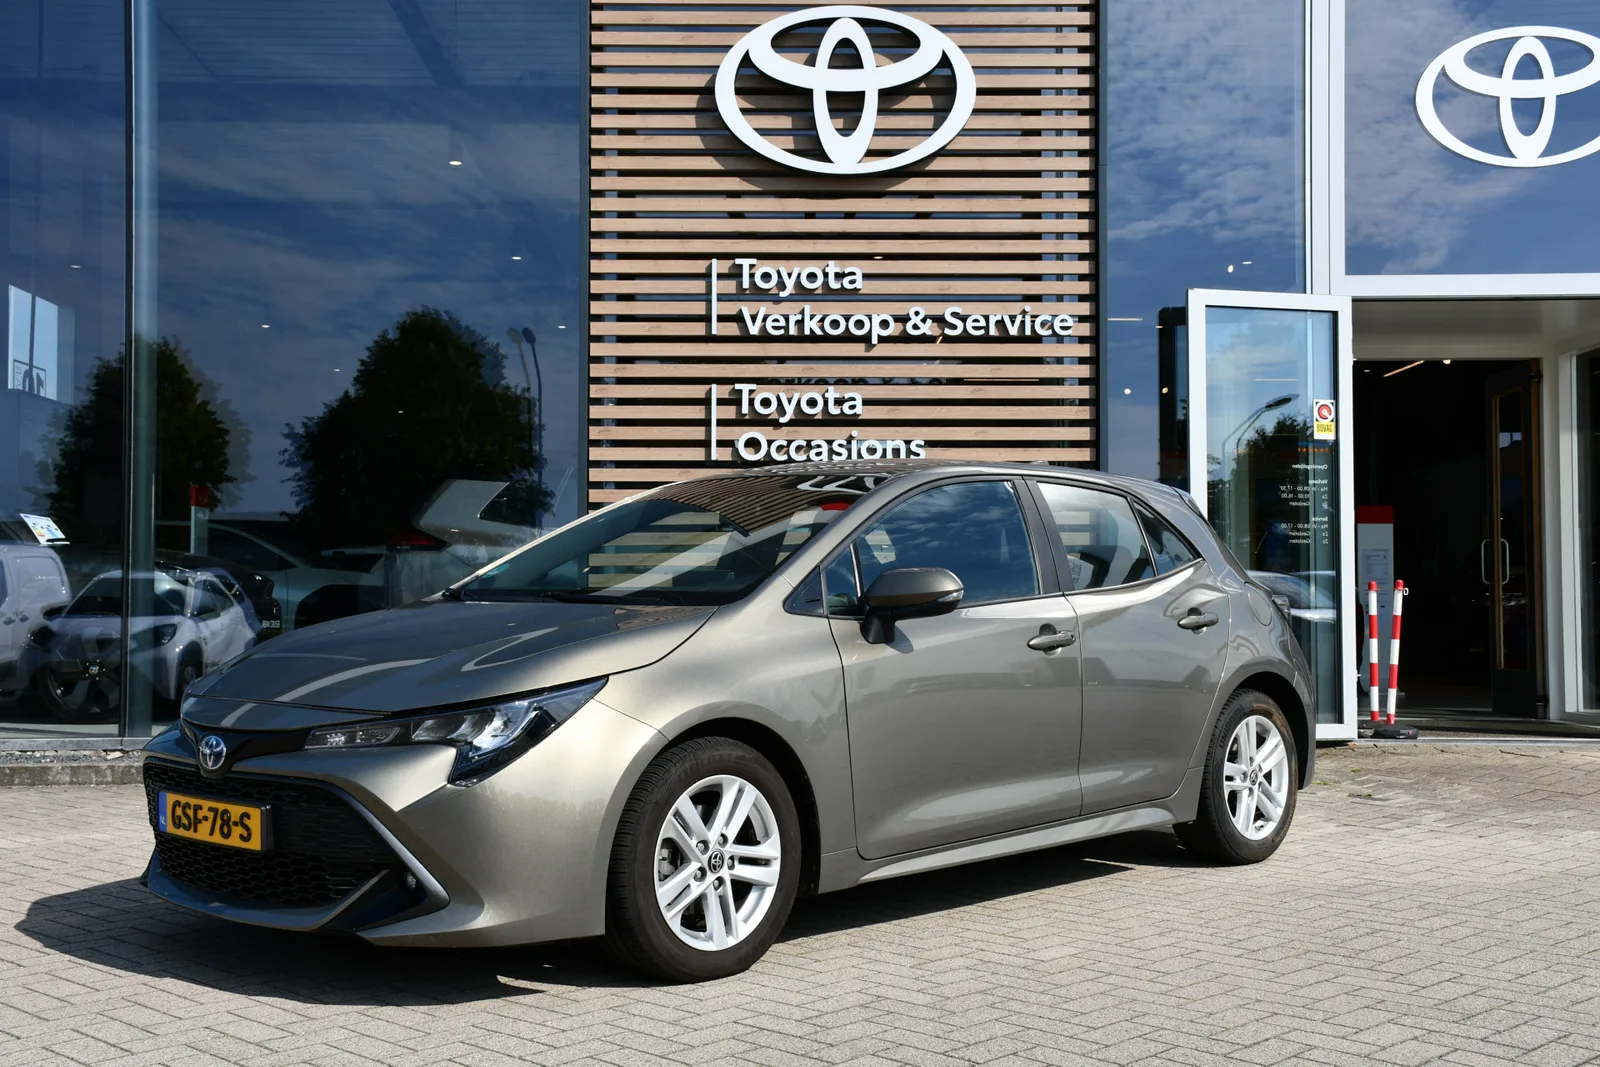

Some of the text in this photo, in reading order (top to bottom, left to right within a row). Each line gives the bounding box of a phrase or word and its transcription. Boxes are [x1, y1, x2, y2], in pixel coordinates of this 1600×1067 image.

[734, 258, 863, 297] Toyota
[741, 304, 1074, 344] Verkoop & Service
[734, 383, 863, 423] Toyota
[736, 431, 926, 461] Occasions
[1316, 423, 1333, 433] BOVAG
[159, 800, 252, 843] NL GSF-78-S
